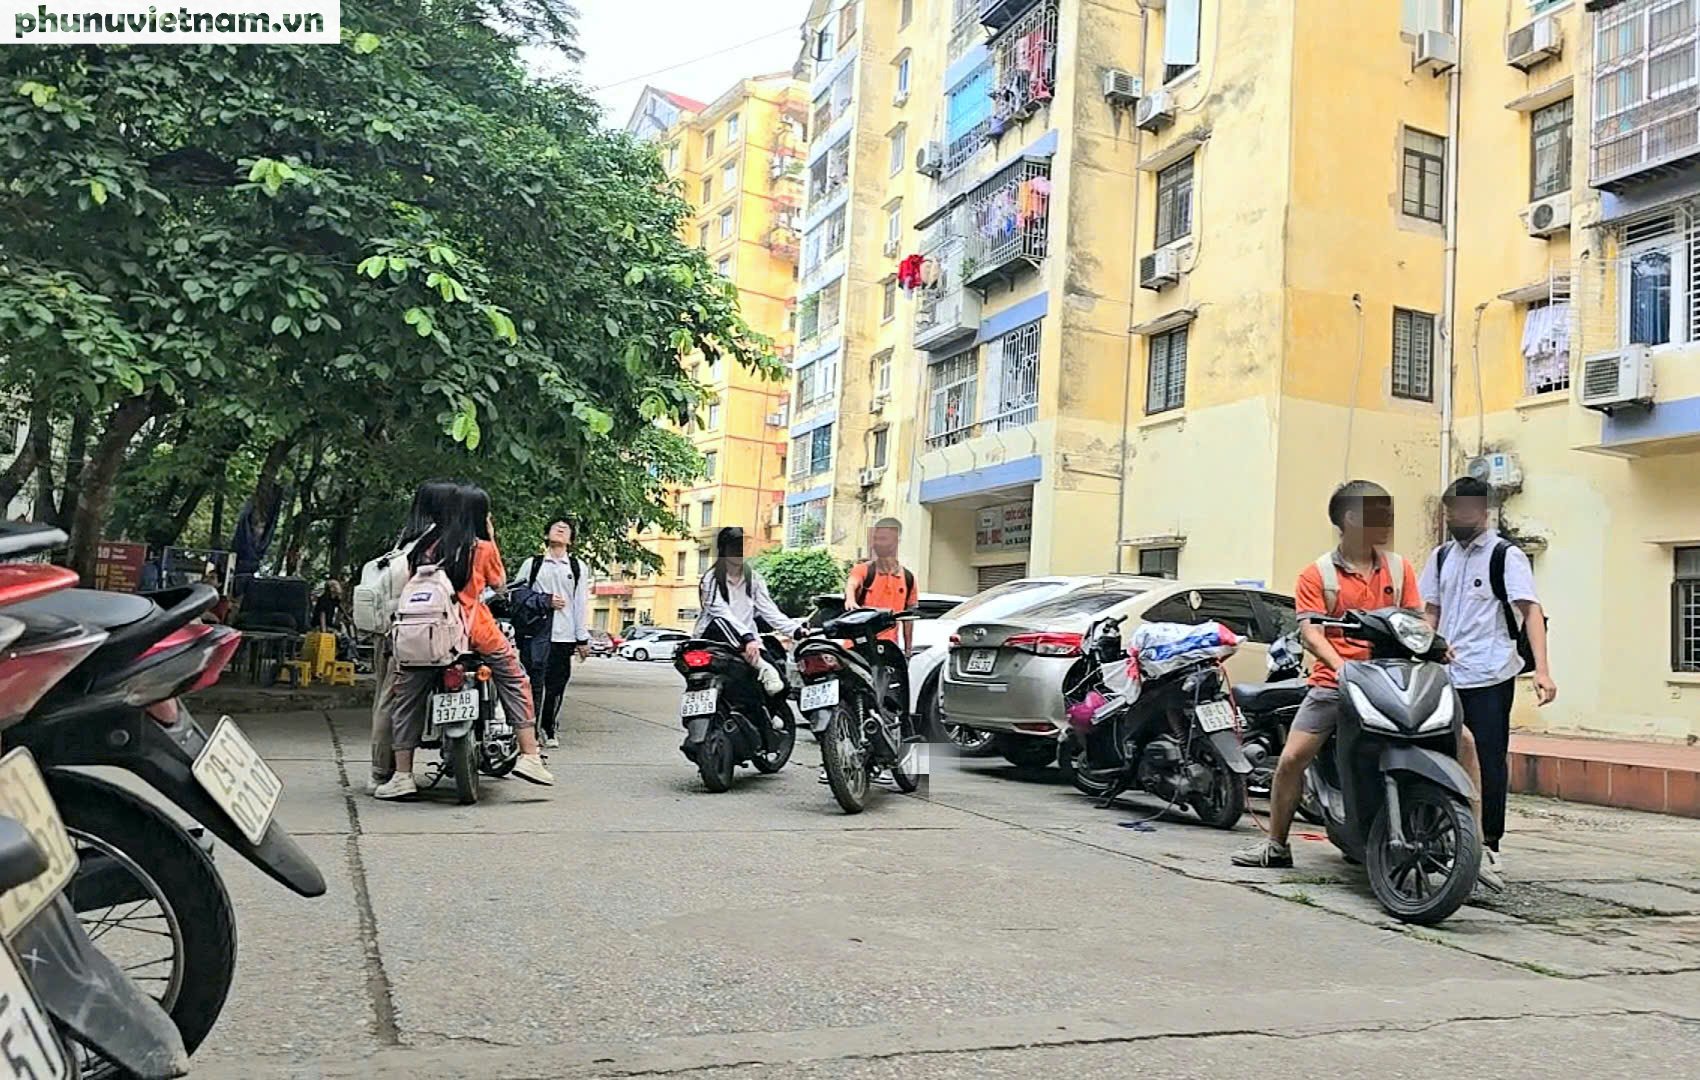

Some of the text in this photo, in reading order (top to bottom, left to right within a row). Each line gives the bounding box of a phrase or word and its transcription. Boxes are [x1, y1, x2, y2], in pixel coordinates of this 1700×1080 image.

[436, 705, 475, 722] 337.22
[440, 692, 471, 707] 29-AB
[204, 730, 250, 795] 29-C1
[231, 758, 278, 834] 021.07
